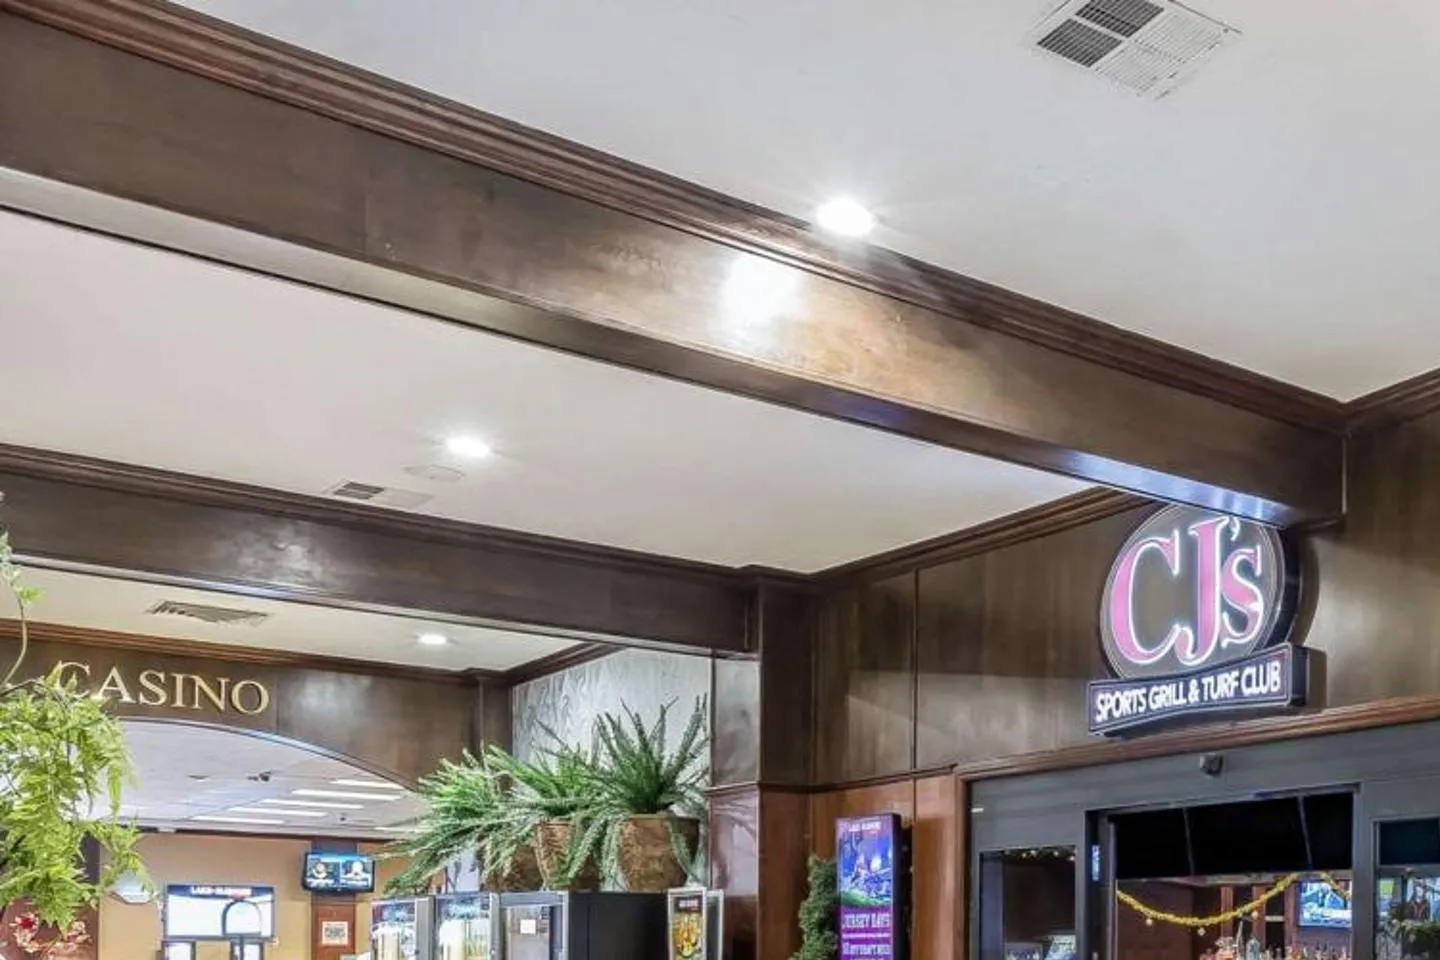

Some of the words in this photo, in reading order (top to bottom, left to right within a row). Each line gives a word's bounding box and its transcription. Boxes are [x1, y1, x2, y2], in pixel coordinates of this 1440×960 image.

[55, 660, 269, 716] CASINO
[1095, 687, 1147, 723] SPORTS
[1148, 680, 1187, 711] GRILL
[1188, 679, 1200, 703] &
[1201, 669, 1240, 699] TURF
[1241, 661, 1281, 697] CLUB
